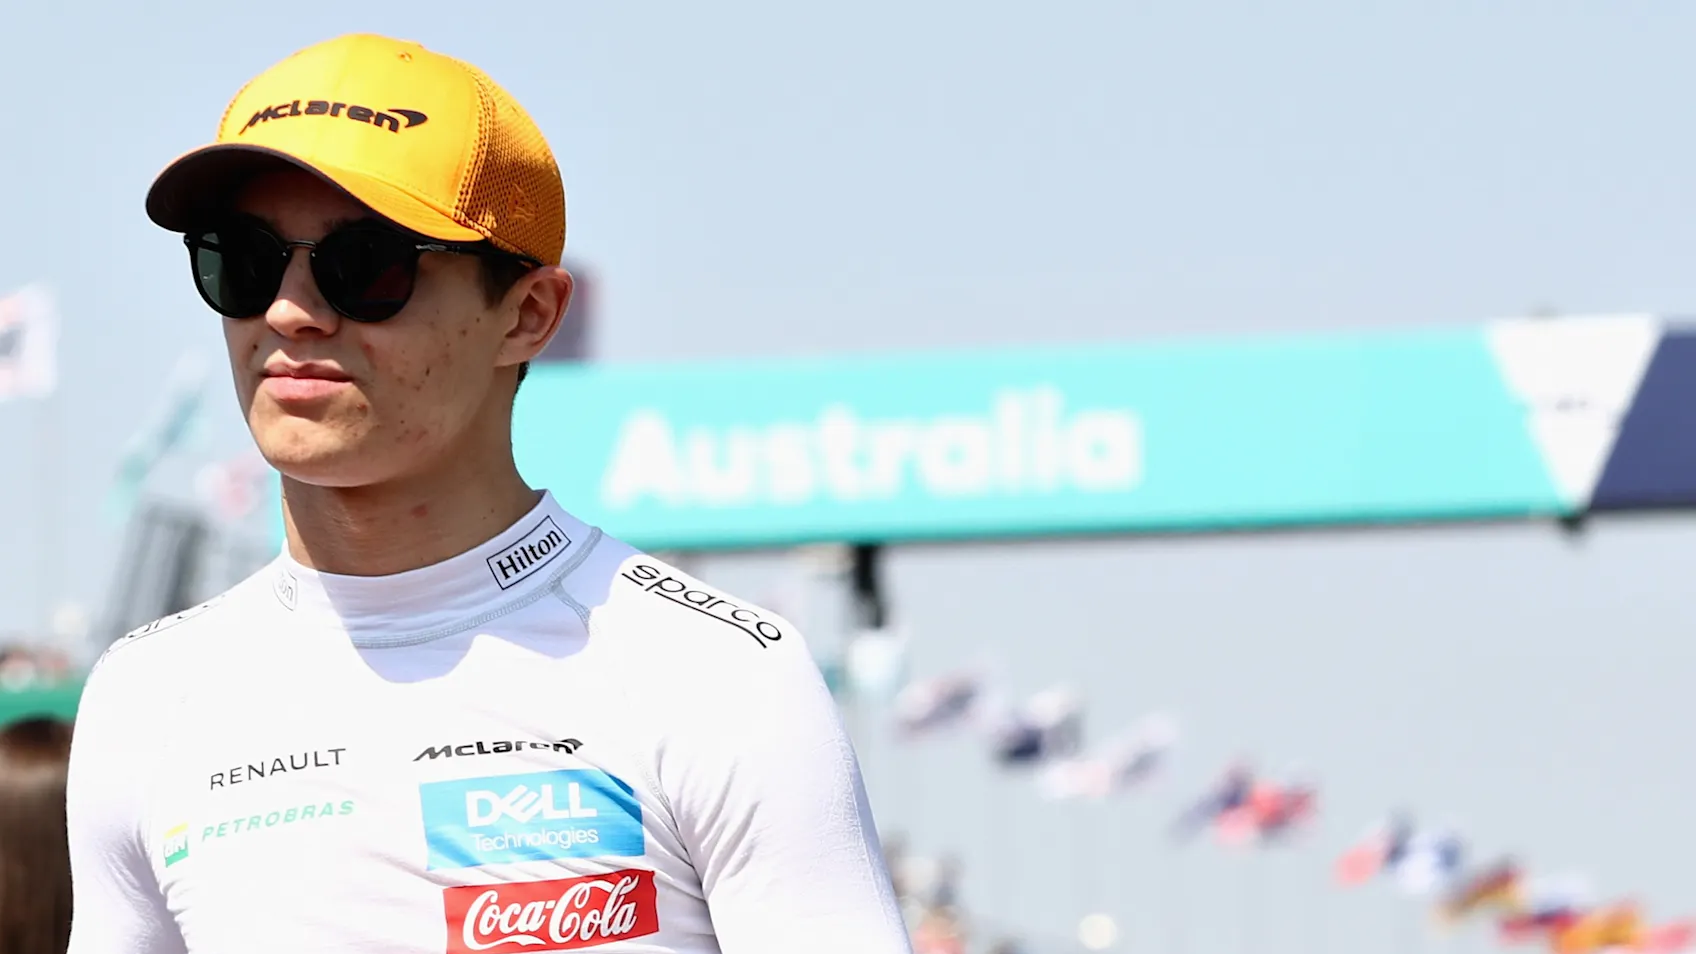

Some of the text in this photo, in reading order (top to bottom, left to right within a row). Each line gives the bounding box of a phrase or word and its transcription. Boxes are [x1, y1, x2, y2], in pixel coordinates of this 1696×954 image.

[238, 99, 400, 136] McLaren
[602, 388, 1144, 506] Australia
[496, 529, 562, 581] Hilton
[631, 564, 783, 643] sparco
[210, 748, 346, 790] RENAULT
[412, 738, 574, 762] McLaren
[202, 800, 354, 842] PETROBRAS
[465, 782, 598, 828] DELL
[470, 827, 600, 853] Technologies
[462, 874, 639, 951] Coca-Cola
